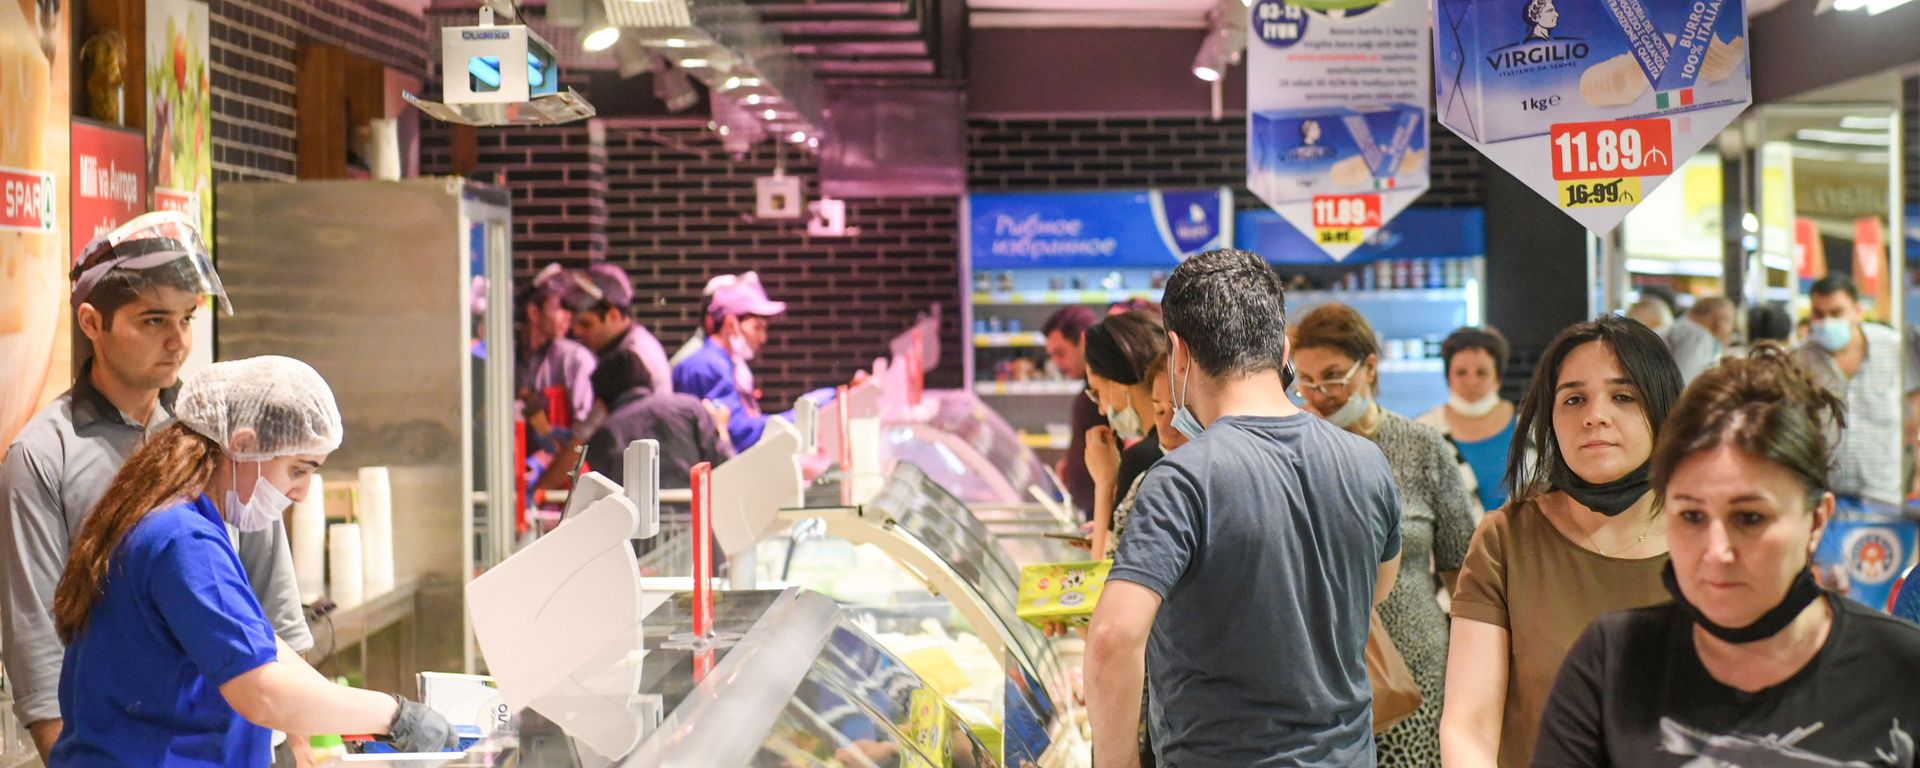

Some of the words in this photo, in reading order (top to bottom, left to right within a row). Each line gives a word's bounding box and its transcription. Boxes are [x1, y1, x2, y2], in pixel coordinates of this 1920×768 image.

[1679, 1, 1706, 48] BURRO
[1681, 44, 1704, 79] 100%
[1696, 0, 1721, 42] ITALIA
[1486, 43, 1590, 71] VIRGILIO
[1499, 67, 1535, 77] ITALIANO
[1521, 100, 1527, 111] 1
[5, 179, 42, 218] SPAR
[110, 160, 138, 211] Avropa
